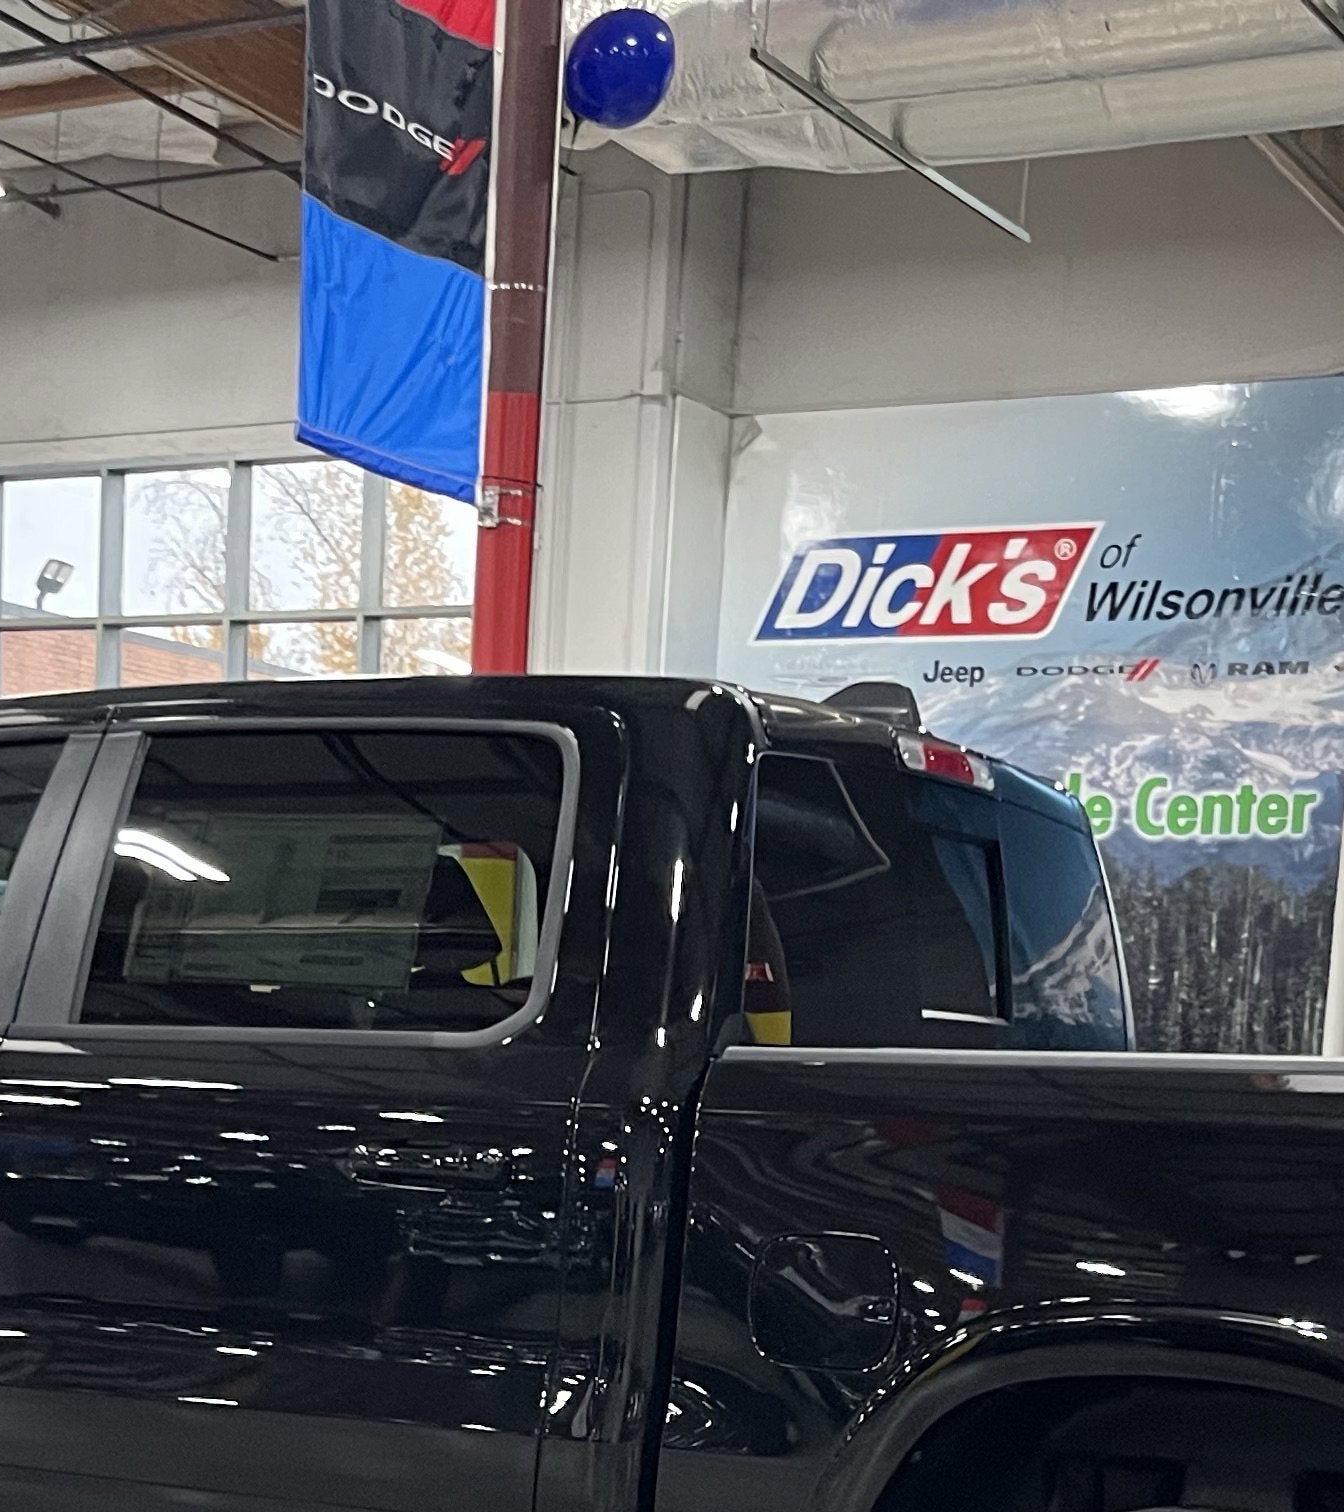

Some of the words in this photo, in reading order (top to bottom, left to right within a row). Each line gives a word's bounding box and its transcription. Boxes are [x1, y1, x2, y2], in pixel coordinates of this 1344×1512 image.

[313, 73, 456, 161] DODGE
[1099, 533, 1142, 569] of
[1085, 573, 1344, 622] Wilsonville
[922, 661, 985, 693] Jeep
[1227, 660, 1310, 676] RAM
[1135, 777, 1318, 836] Center
